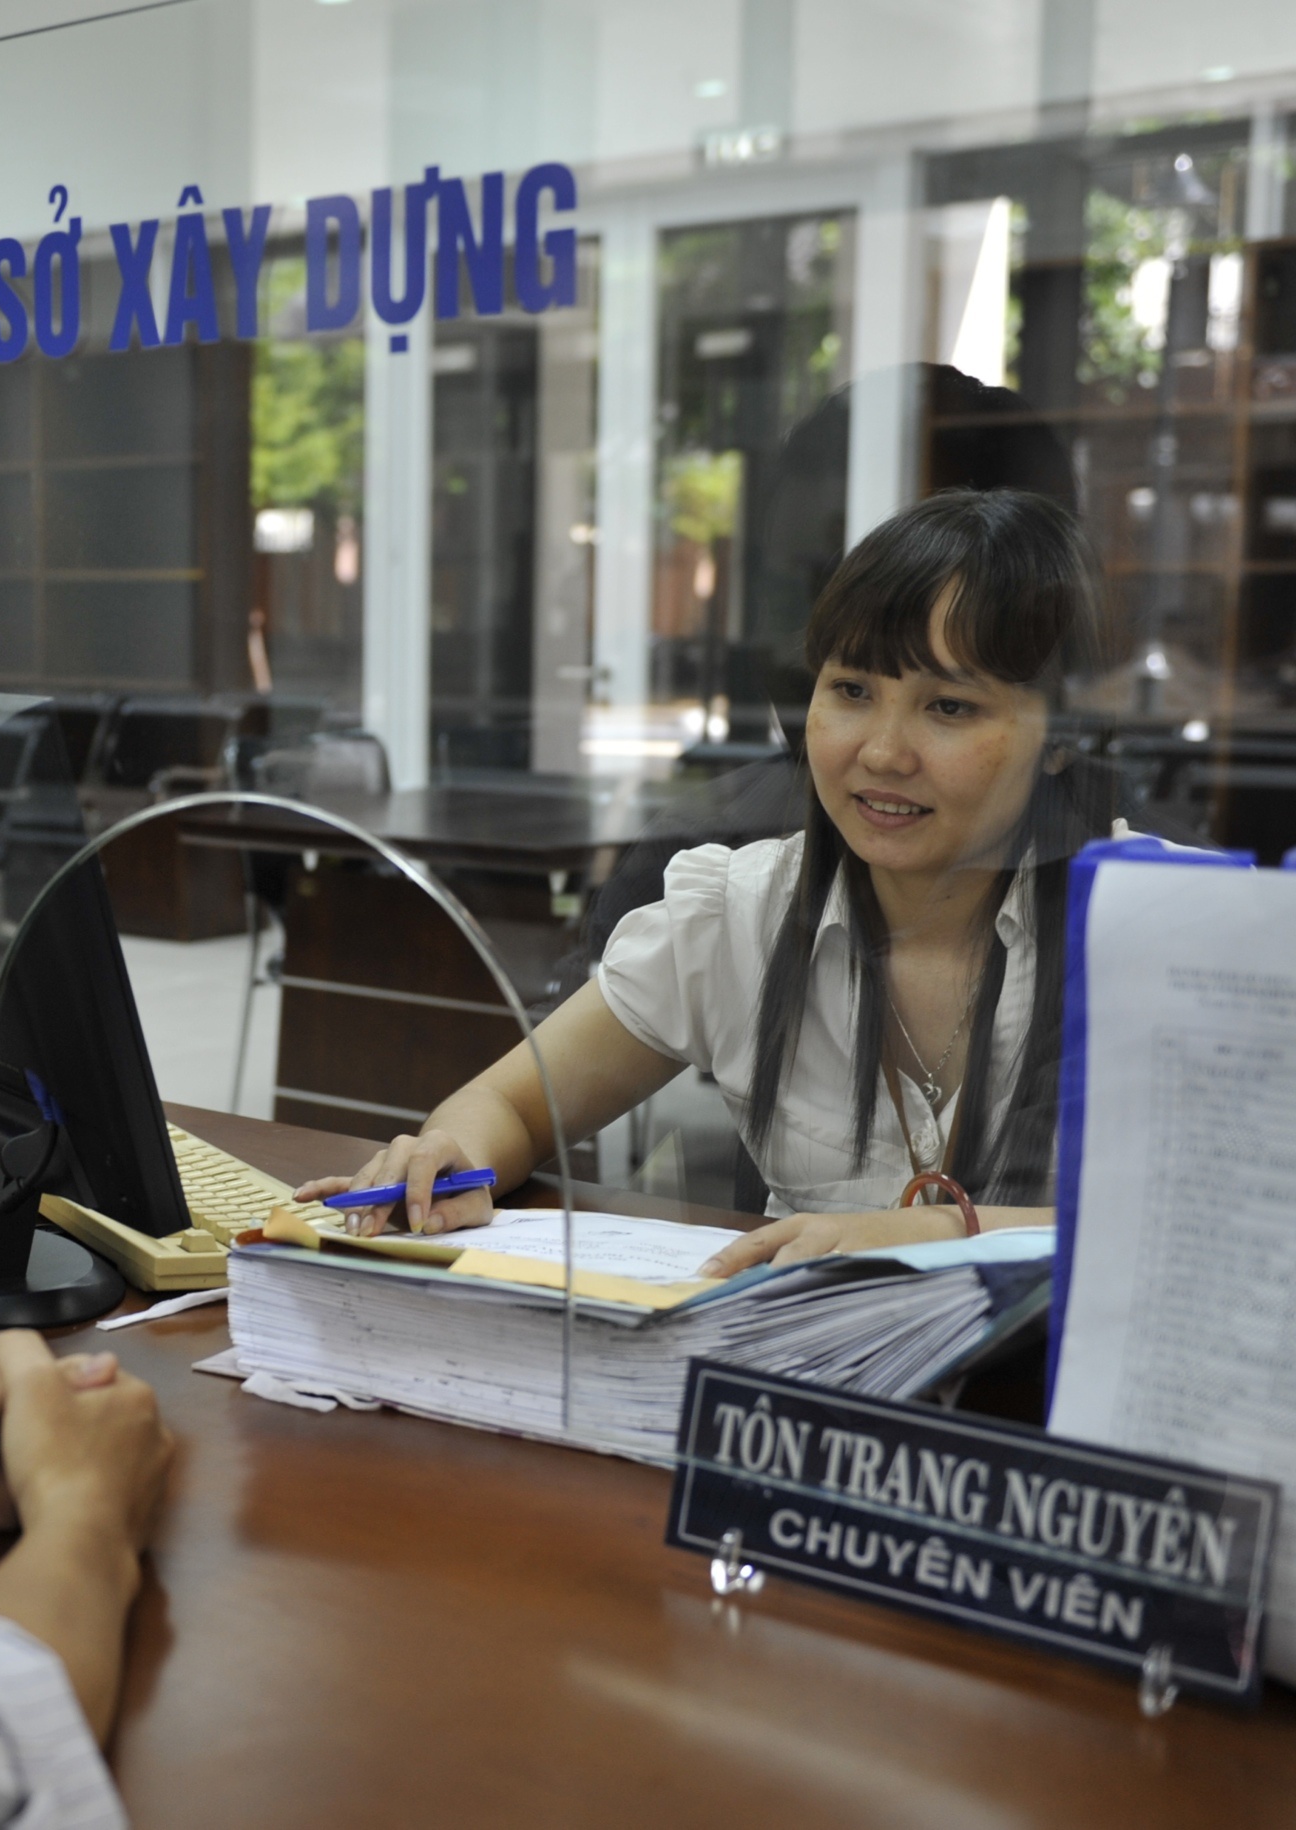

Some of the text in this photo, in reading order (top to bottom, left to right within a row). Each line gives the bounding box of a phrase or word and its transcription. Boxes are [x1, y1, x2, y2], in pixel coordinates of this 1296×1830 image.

[109, 185, 274, 352] XÂY
[305, 161, 580, 354] DỰNG
[713, 1393, 1238, 1588] TÔN TRANG NGUYÊN
[769, 1508, 1144, 1640] CHUYÊN VIÊN
